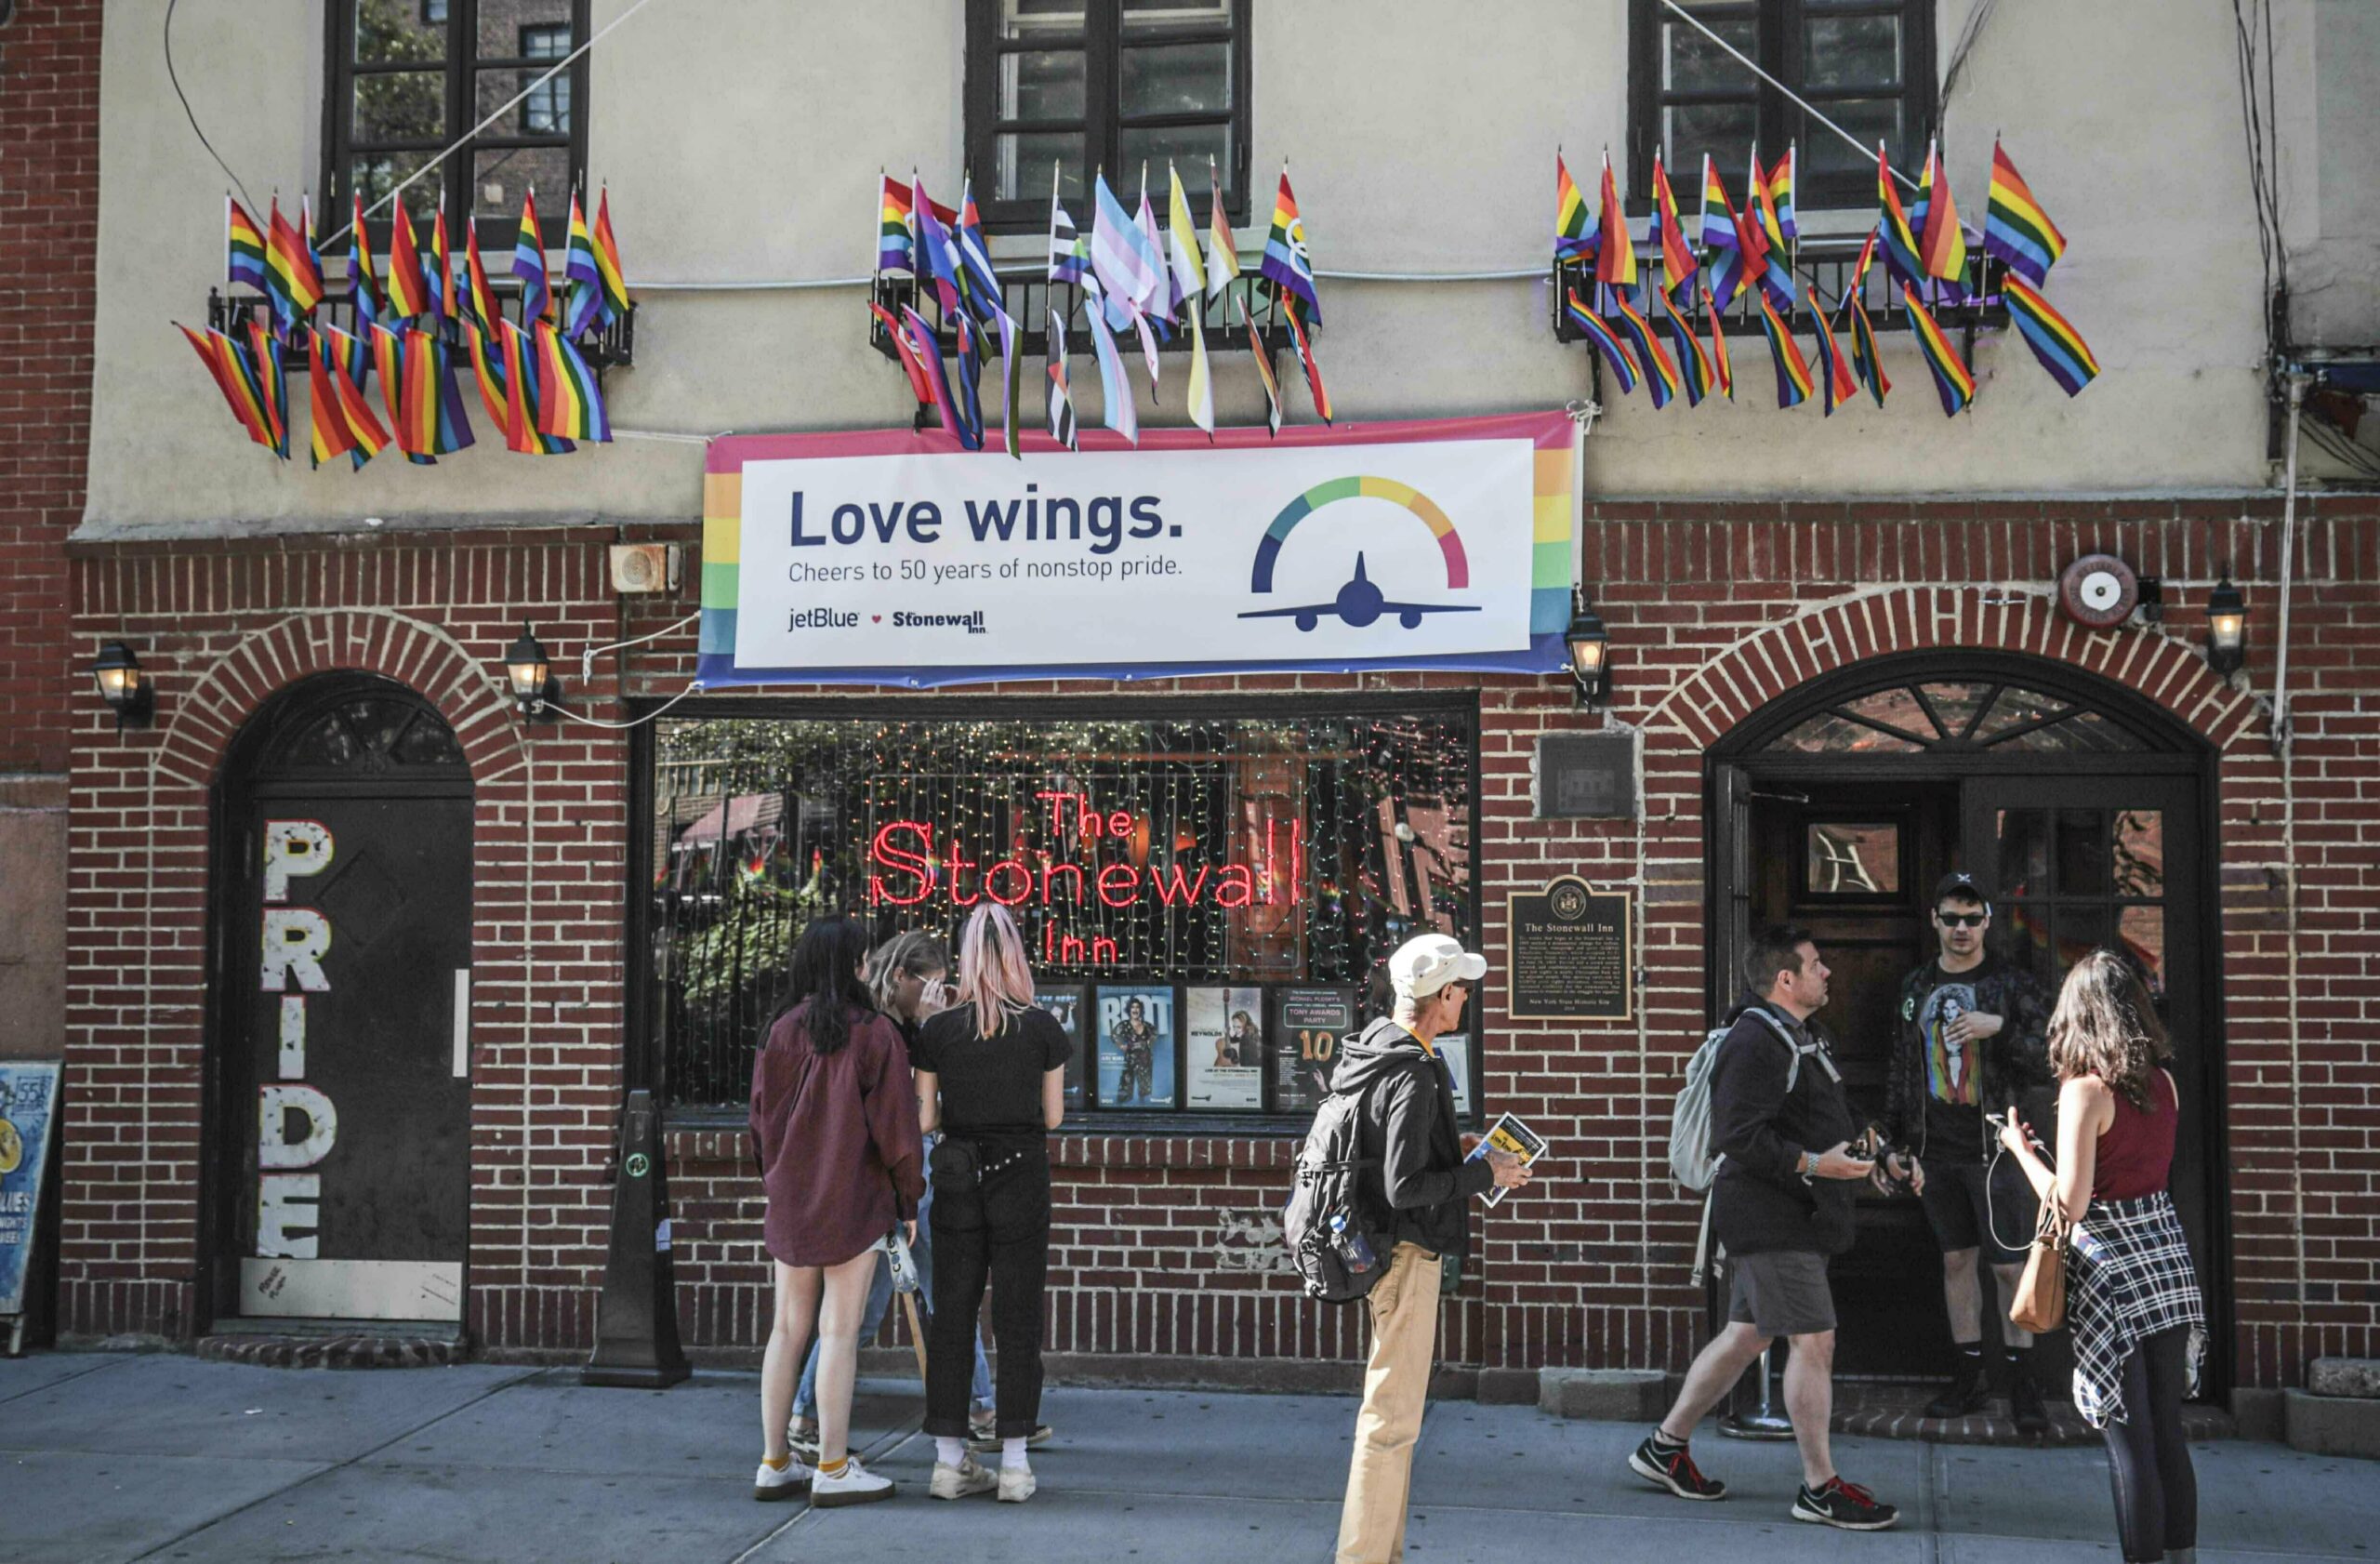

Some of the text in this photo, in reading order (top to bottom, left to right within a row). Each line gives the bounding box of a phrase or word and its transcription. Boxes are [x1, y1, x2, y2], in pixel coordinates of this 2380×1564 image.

[790, 484, 1183, 555] Love wings.
[789, 555, 1183, 585] Cheers to 50 years of nonstop pride.
[787, 607, 985, 632] jetBlue Stonewall
[968, 625, 986, 634] Inn
[1036, 793, 1133, 838] The
[870, 817, 1300, 908] Stonewall
[1045, 919, 1118, 966] Inn
[1525, 923, 1614, 933] The Stonewall Inn
[257, 819, 337, 1259] PRIDE
[1299, 1029, 1334, 1062] 10
